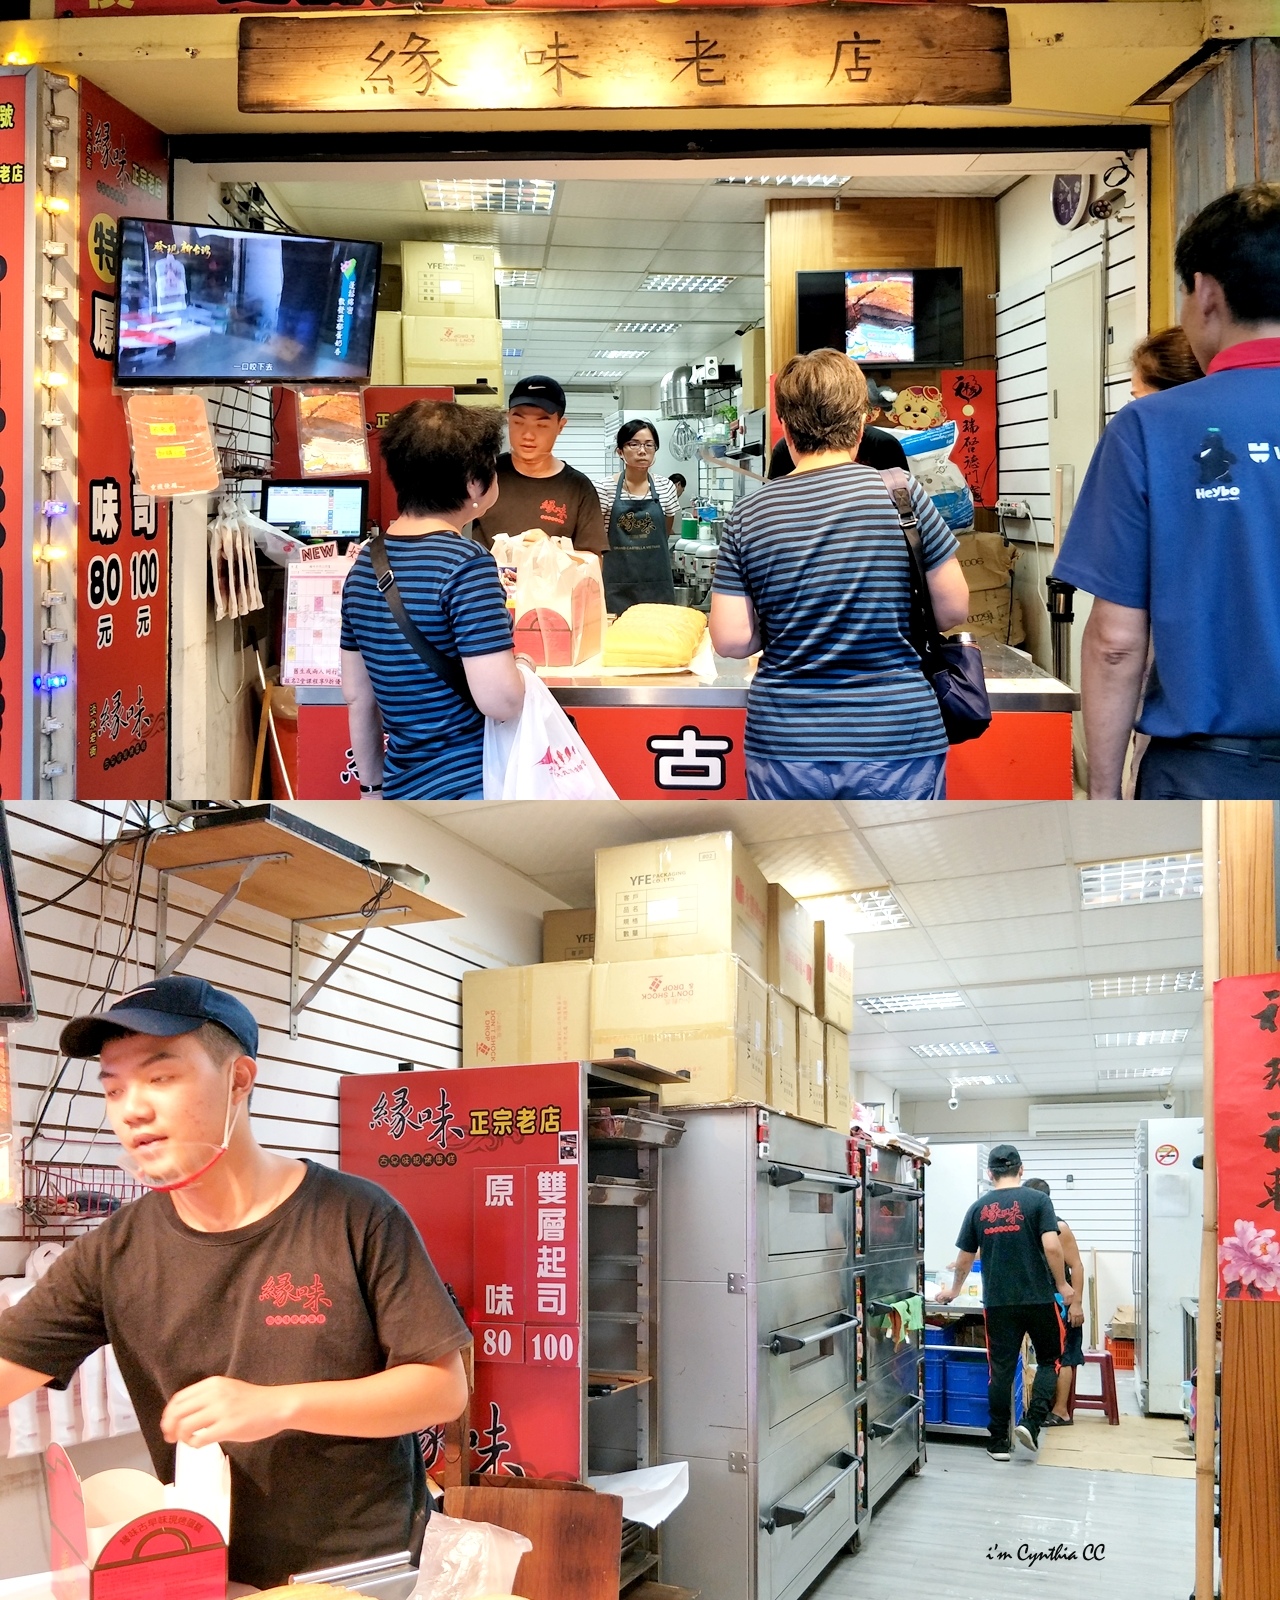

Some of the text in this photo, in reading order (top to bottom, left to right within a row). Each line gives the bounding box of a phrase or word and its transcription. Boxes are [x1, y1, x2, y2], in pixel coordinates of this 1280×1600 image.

[360, 30, 881, 97] 緣味老店
[0, 165, 24, 183] 老店
[427, 262, 443, 270] YFE
[233, 362, 273, 371] 一口咬下去
[1195, 485, 1240, 500] Heybo
[301, 544, 335, 562] NEW
[89, 556, 122, 608] 80
[131, 550, 159, 599] 100
[98, 615, 113, 648] 元
[139, 606, 150, 637] 元
[648, 727, 732, 786] 古
[630, 874, 652, 886] YFE
[576, 933, 595, 943] YFE
[641, 991, 669, 1000] SHOCK
[662, 983, 685, 991] DROP
[469, 1105, 562, 1136] 正宗老店
[536, 1171, 567, 1317] 雙層起司
[483, 1329, 512, 1357] 80
[531, 1333, 574, 1361] 100
